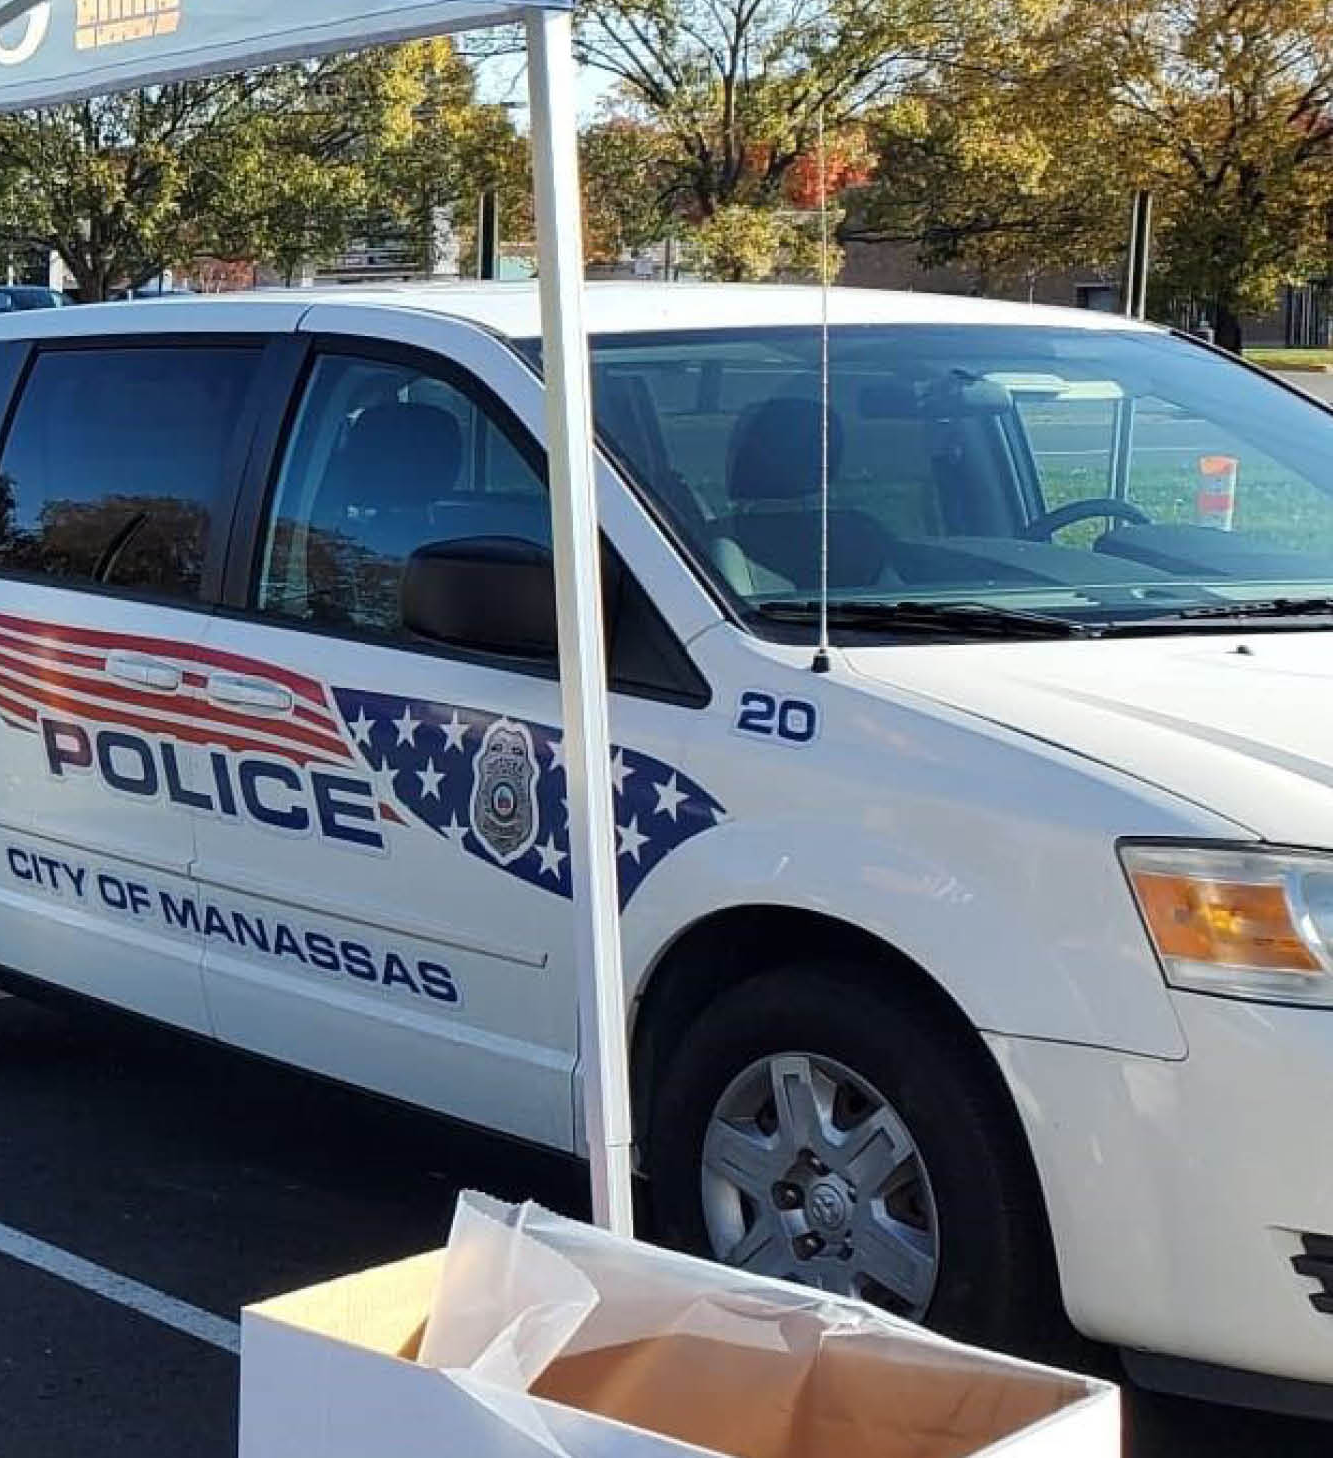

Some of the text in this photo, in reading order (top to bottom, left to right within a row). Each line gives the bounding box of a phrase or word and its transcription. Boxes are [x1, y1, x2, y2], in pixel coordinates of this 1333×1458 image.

[41, 717, 385, 849] POLICE
[738, 692, 817, 743] 20
[7, 847, 459, 1003] CITY OF MANASSAS
